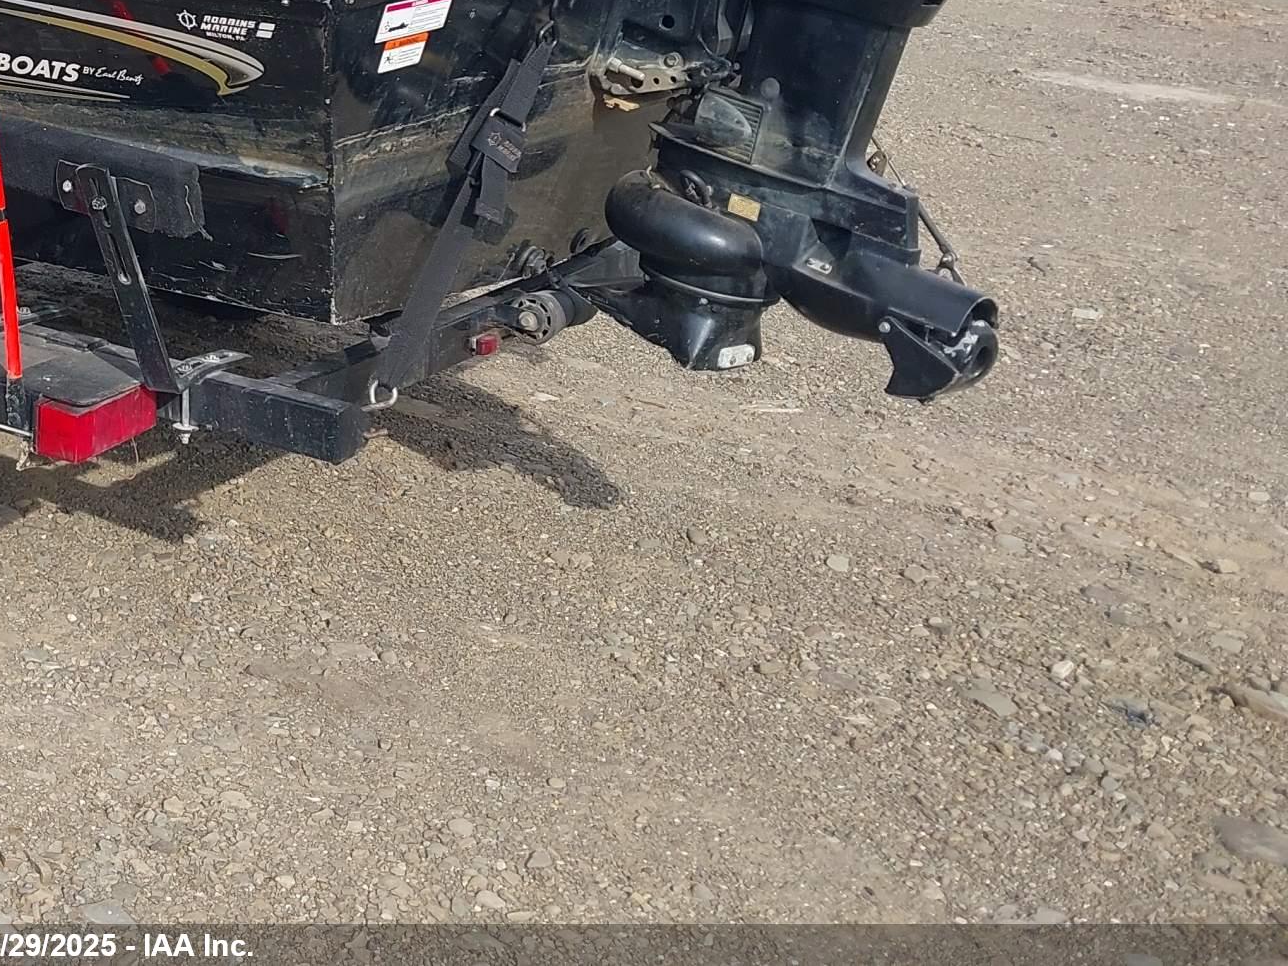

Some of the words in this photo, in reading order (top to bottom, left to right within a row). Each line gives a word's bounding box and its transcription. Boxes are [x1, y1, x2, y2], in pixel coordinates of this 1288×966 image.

[200, 22, 249, 36] MARINE
[202, 15, 256, 29] ROBBINS
[82, 66, 95, 75] BY
